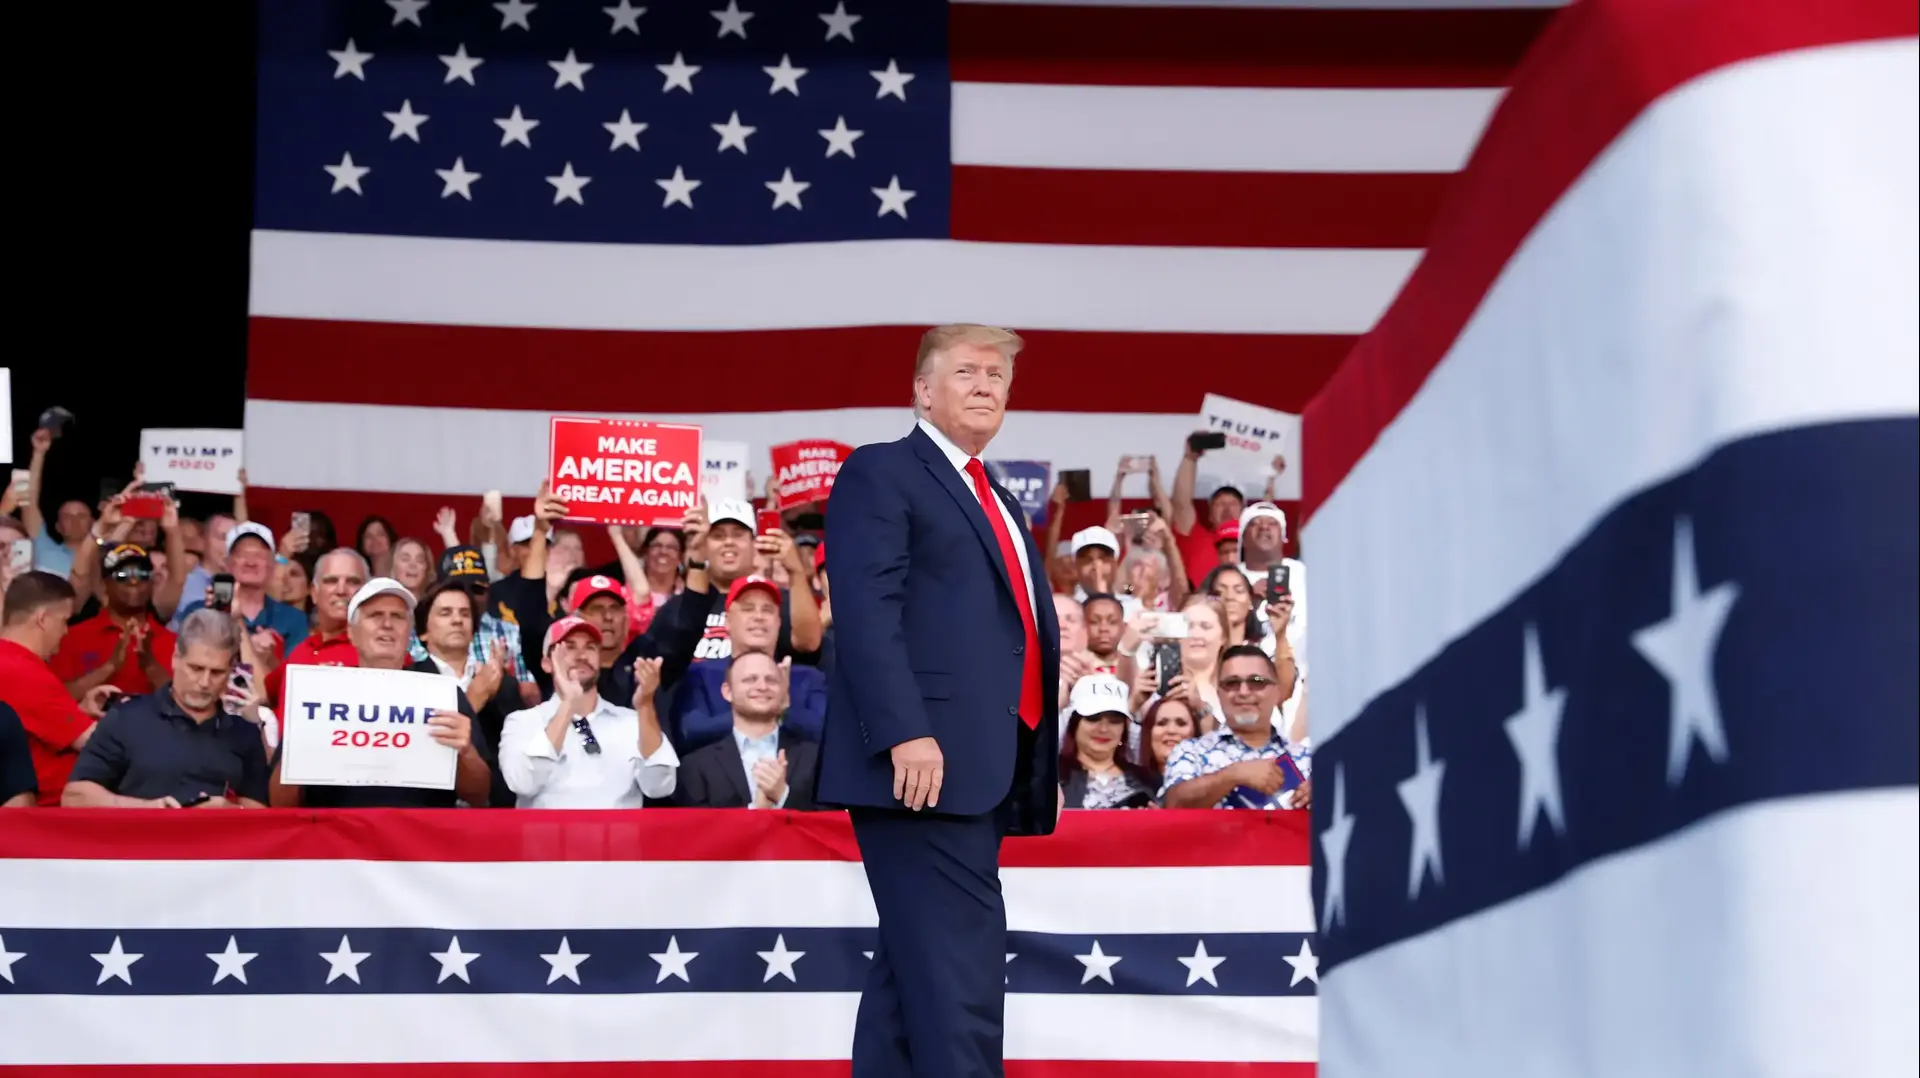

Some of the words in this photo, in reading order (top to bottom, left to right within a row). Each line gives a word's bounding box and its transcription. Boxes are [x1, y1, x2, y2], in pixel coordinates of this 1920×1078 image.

[1209, 414, 1281, 440] TRUMP
[151, 446, 234, 458] TRUMP
[597, 435, 658, 456] MAKE
[798, 447, 838, 460] MAKE
[1226, 434, 1262, 452] 020
[168, 459, 216, 471] 2020
[556, 455, 695, 486] AMERICA
[779, 460, 844, 482] AMERI
[555, 483, 626, 504] GREAT
[627, 487, 695, 508] AGAIN
[693, 637, 732, 659] 020
[330, 729, 412, 749] 2020
